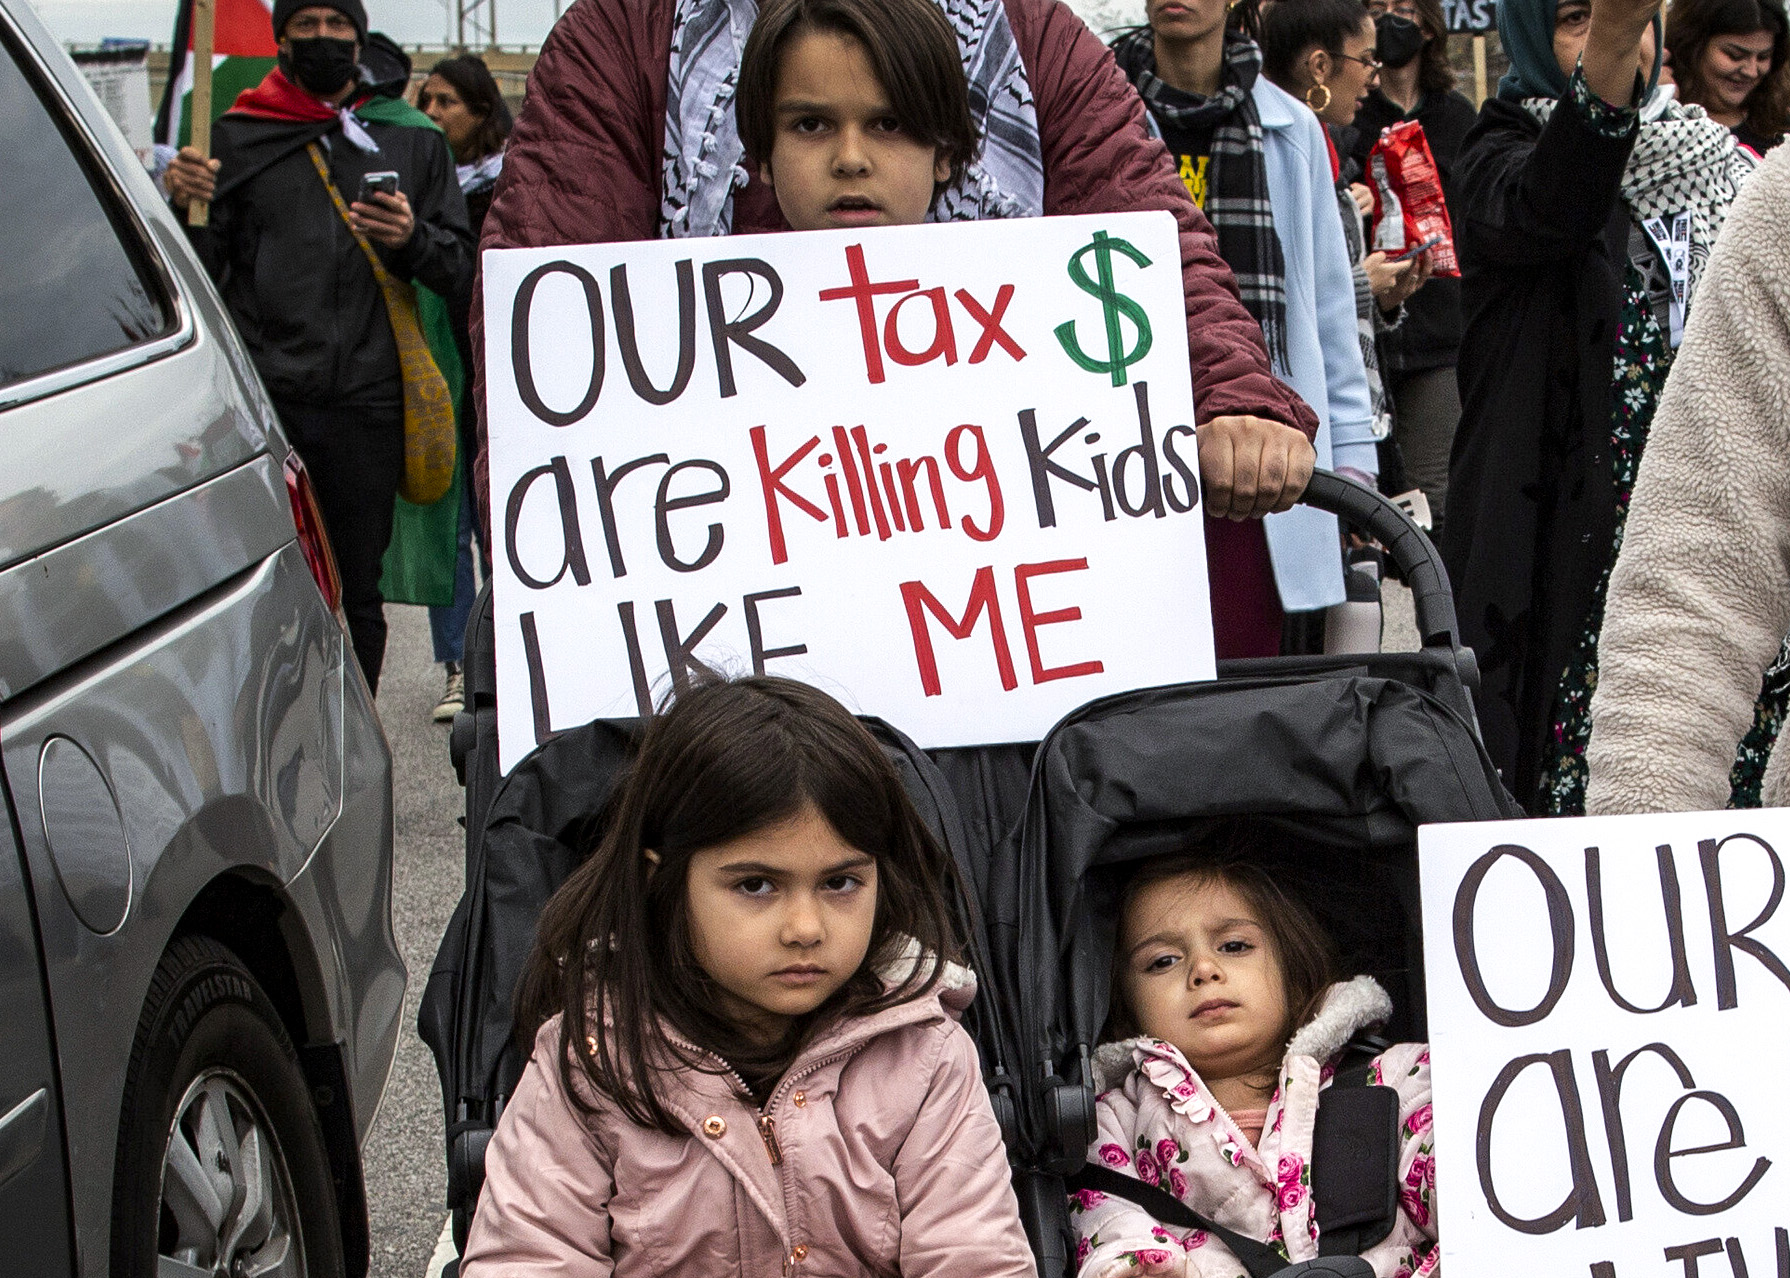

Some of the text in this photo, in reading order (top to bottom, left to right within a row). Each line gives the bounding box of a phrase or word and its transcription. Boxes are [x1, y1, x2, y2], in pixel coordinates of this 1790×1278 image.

[511, 258, 806, 427] OUR
[819, 243, 1027, 384] tax
[1054, 230, 1154, 388] $
[505, 381, 1199, 589] are Killing Kids
[899, 556, 1104, 697] ME
[1475, 1042, 1773, 1235] are
